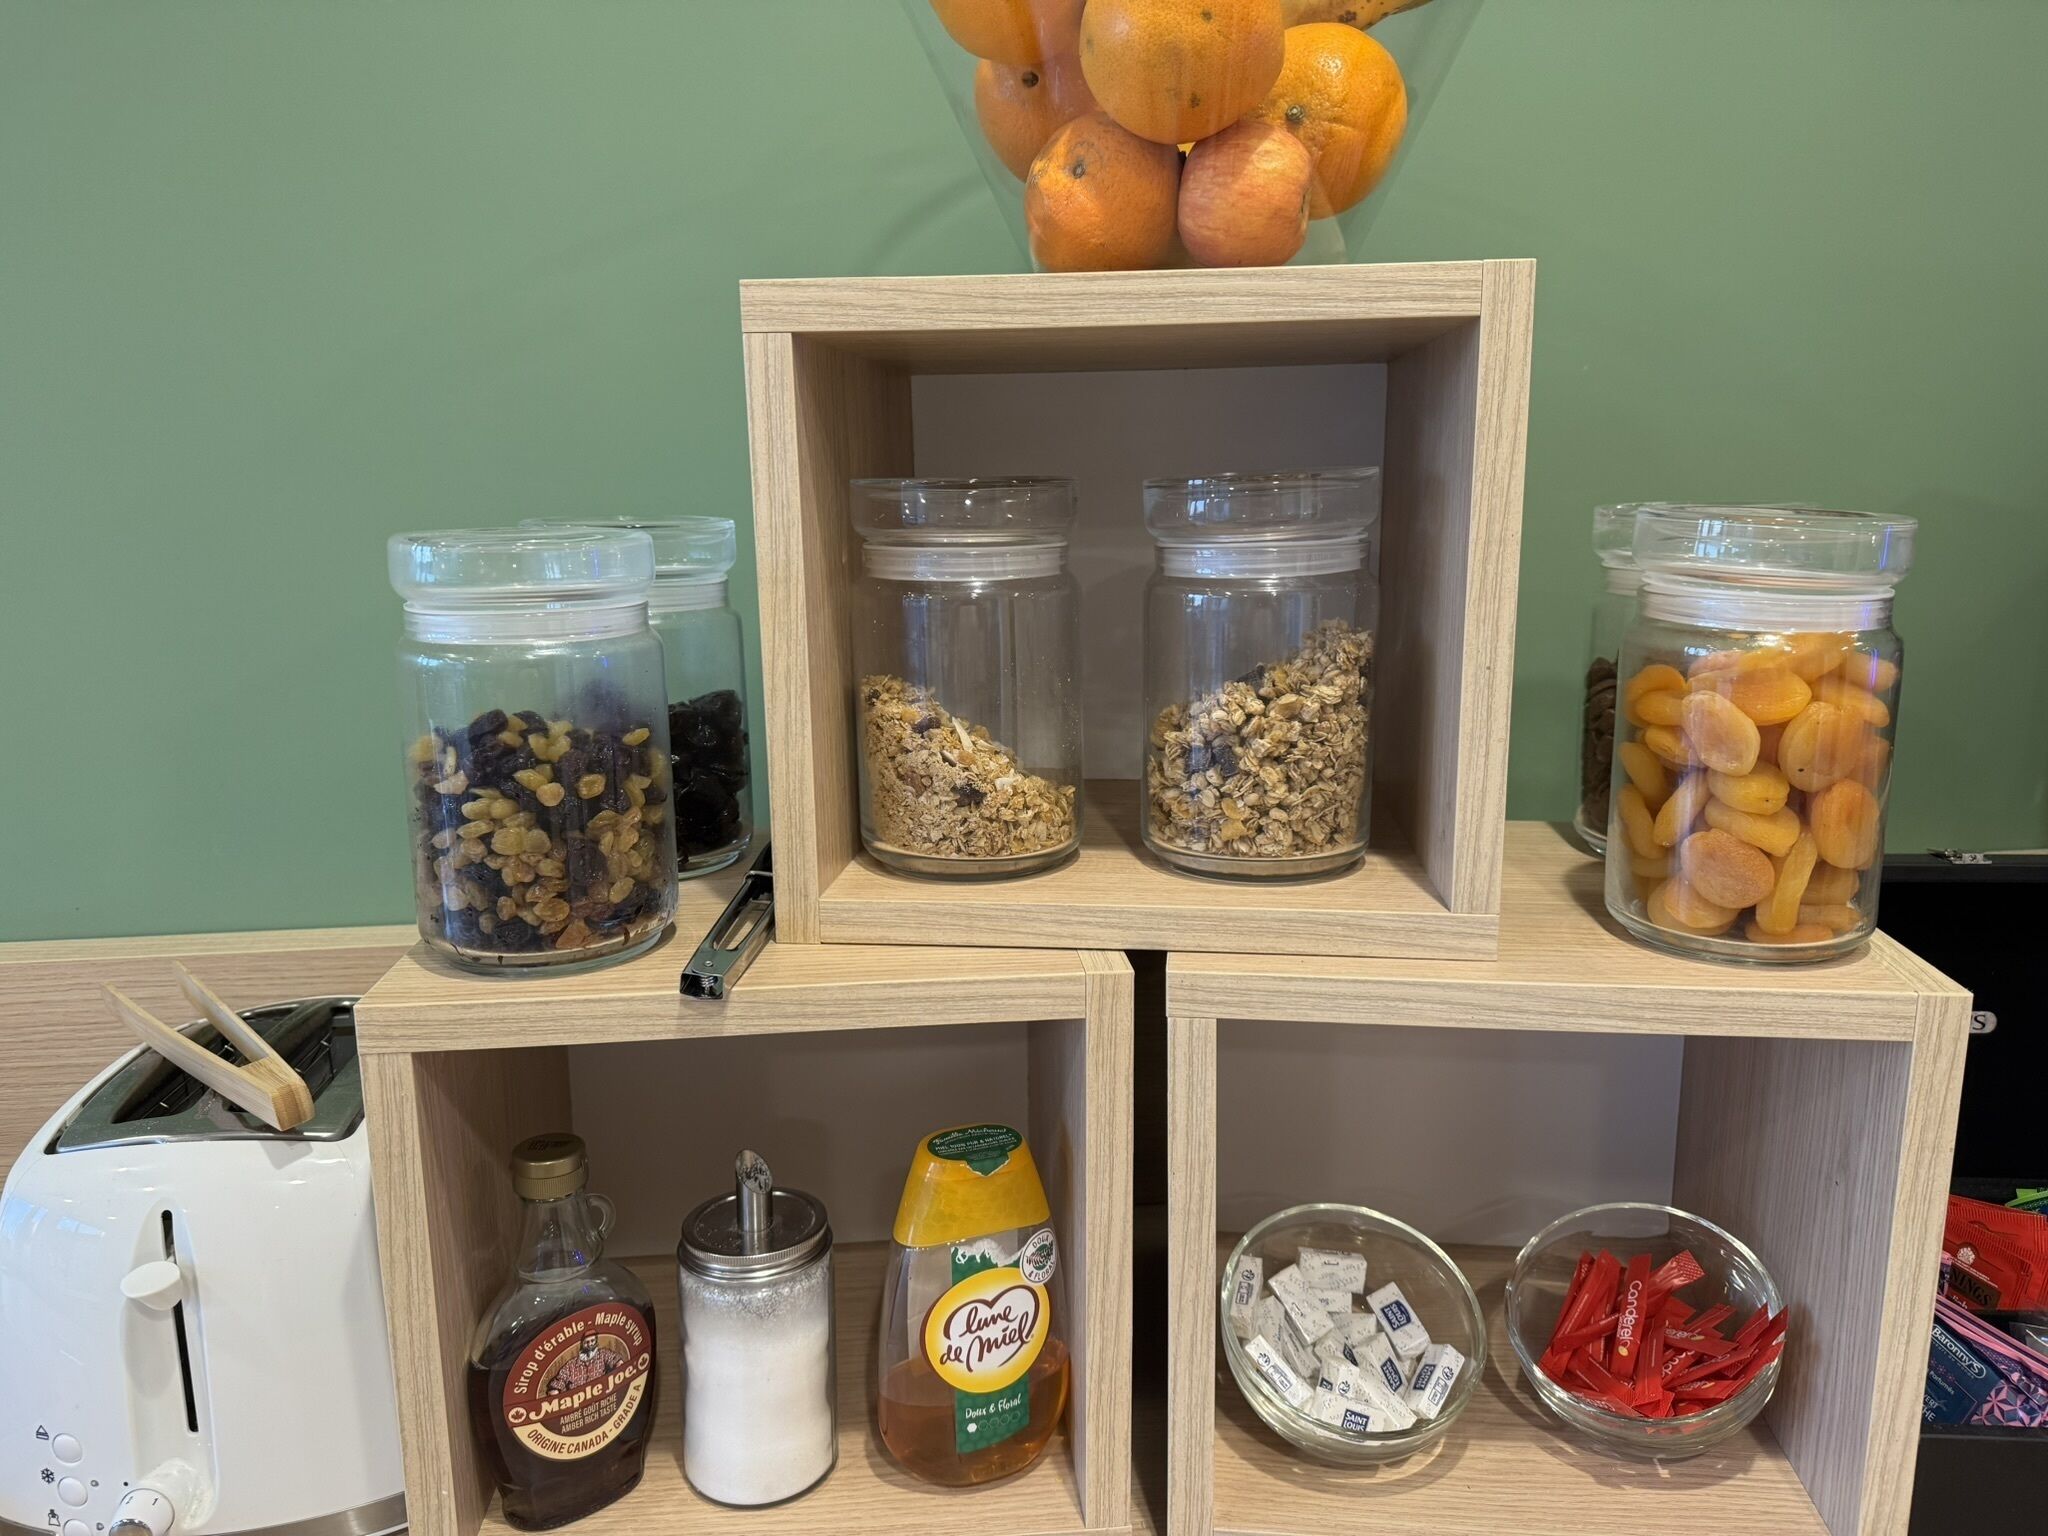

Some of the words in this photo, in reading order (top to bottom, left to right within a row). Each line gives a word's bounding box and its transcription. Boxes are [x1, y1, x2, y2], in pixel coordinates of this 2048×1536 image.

[1971, 1014, 1986, 1031] S
[1949, 1268, 1994, 1306] NINGS
[1384, 1307, 1400, 1329] SAINT
[1390, 1303, 1407, 1325] LOUIS
[1619, 1280, 1642, 1340] Canderel
[514, 1360, 539, 1394] Sirop
[534, 1320, 585, 1361] d'érable
[595, 1312, 626, 1327] Maple
[625, 1319, 644, 1347] syrup
[940, 1344, 964, 1365] de
[529, 1384, 603, 1421] Maple
[606, 1365, 637, 1395] Joe
[965, 1407, 986, 1419] Doux
[998, 1393, 1021, 1412] Floral
[527, 1429, 567, 1454] ORIGINE
[566, 1431, 609, 1454] CANADA
[613, 1394, 638, 1430] GRADE
[633, 1384, 642, 1392] A
[560, 1409, 582, 1426] AMBRÉ
[600, 1393, 617, 1407] RICHE
[562, 1419, 583, 1434] AMBER
[584, 1411, 599, 1425] RICH
[600, 1402, 617, 1417] TASTE
[1344, 1411, 1367, 1425] SAINT
[1922, 1405, 1936, 1422] HE
[1343, 1420, 1365, 1432] LOUIS
